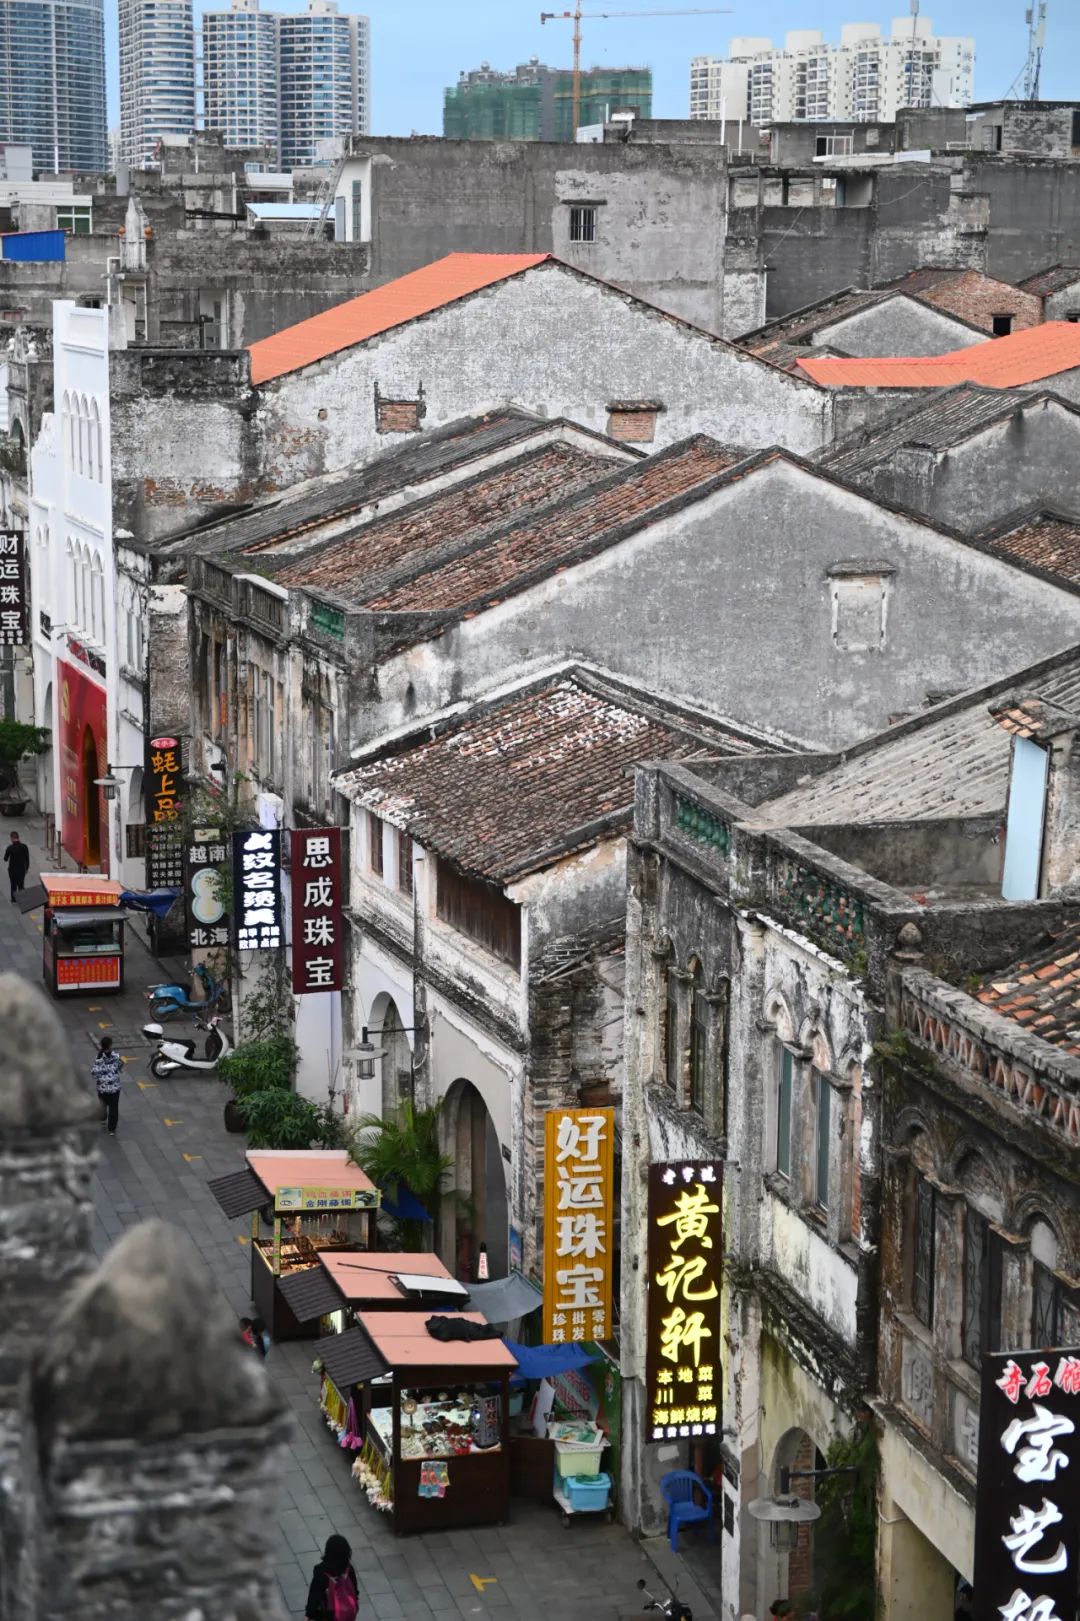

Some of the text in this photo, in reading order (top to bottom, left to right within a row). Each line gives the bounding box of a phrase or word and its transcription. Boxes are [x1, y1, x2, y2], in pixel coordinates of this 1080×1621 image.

[0, 535, 21, 630] 财运珠宝
[151, 751, 180, 822] 蚝上品
[189, 845, 225, 863] 越南
[190, 927, 229, 946] 北海
[303, 836, 335, 987] 思成珠宝
[555, 1116, 606, 1310] 好运珠宝
[656, 1184, 720, 1367] 黄记轩
[656, 1365, 714, 1385] 本地菜
[995, 1356, 1080, 1404] 奇石馆
